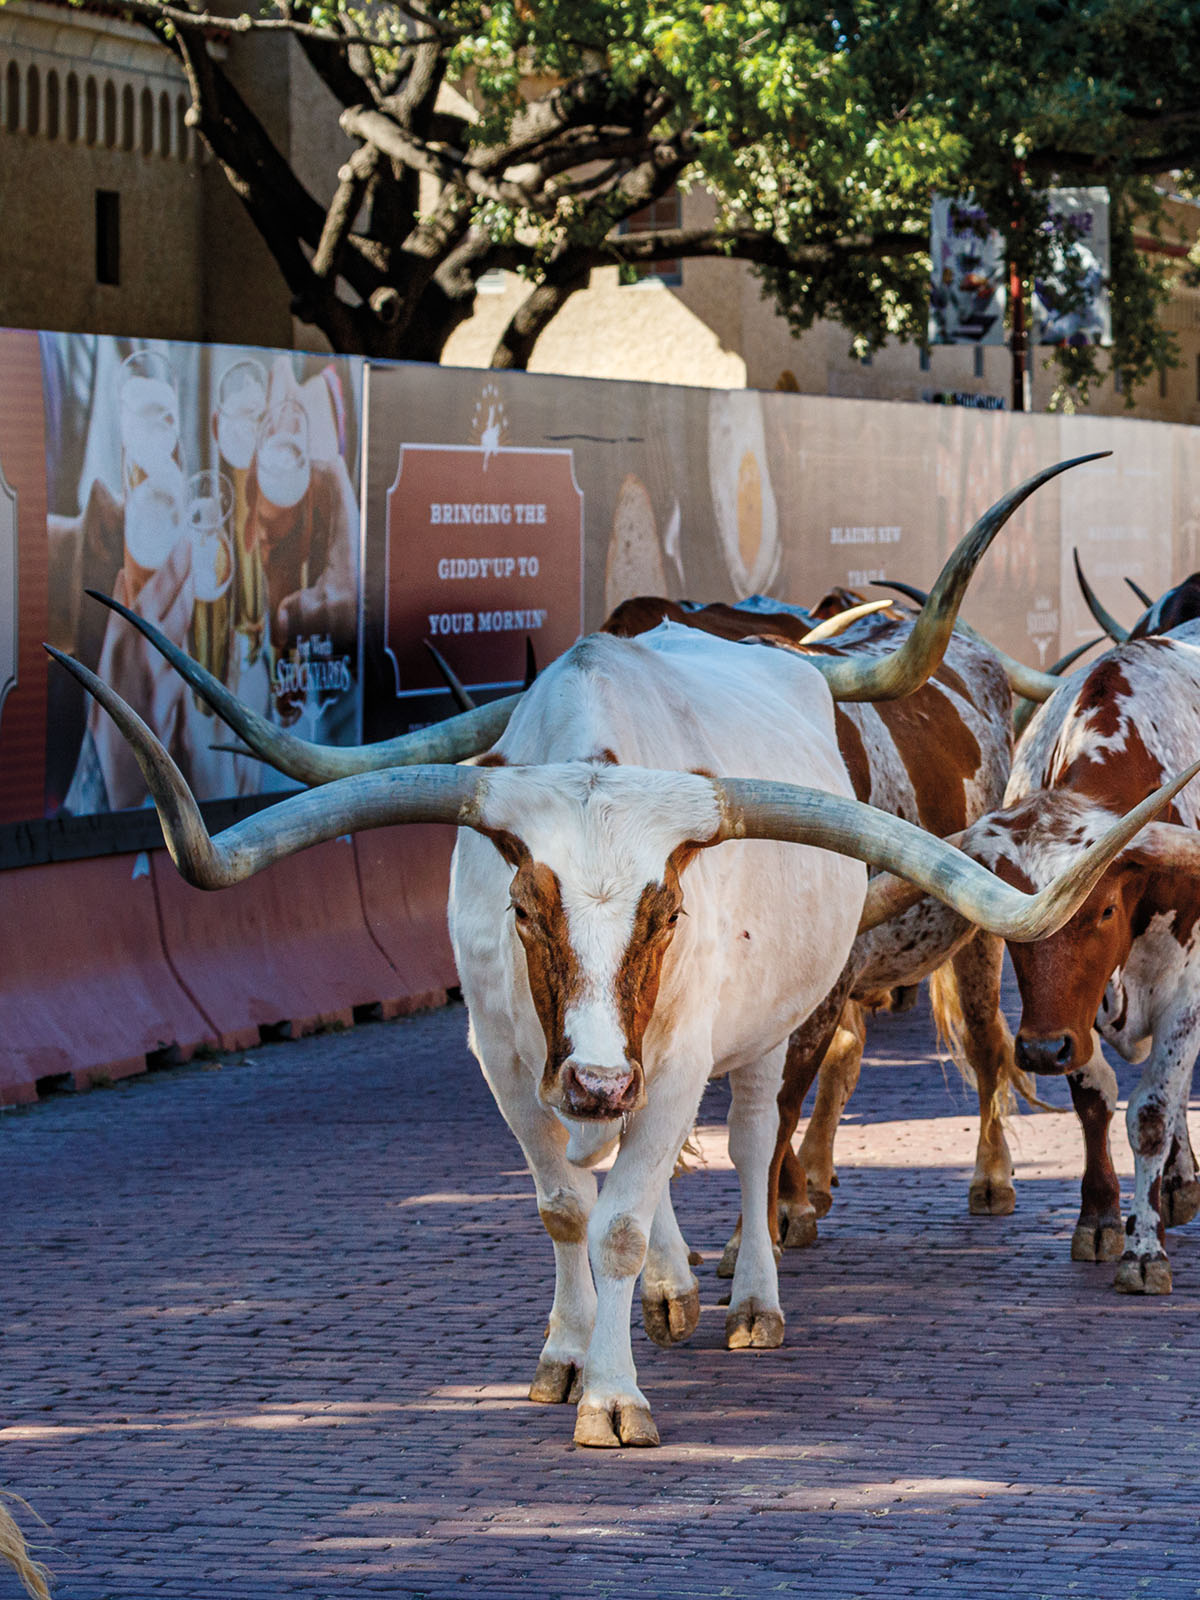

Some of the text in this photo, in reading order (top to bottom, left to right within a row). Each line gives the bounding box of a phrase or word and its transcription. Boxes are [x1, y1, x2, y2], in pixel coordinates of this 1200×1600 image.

[430, 503, 547, 525] BRINGING THE
[518, 556, 540, 578] TO
[429, 613, 475, 635] YOUR
